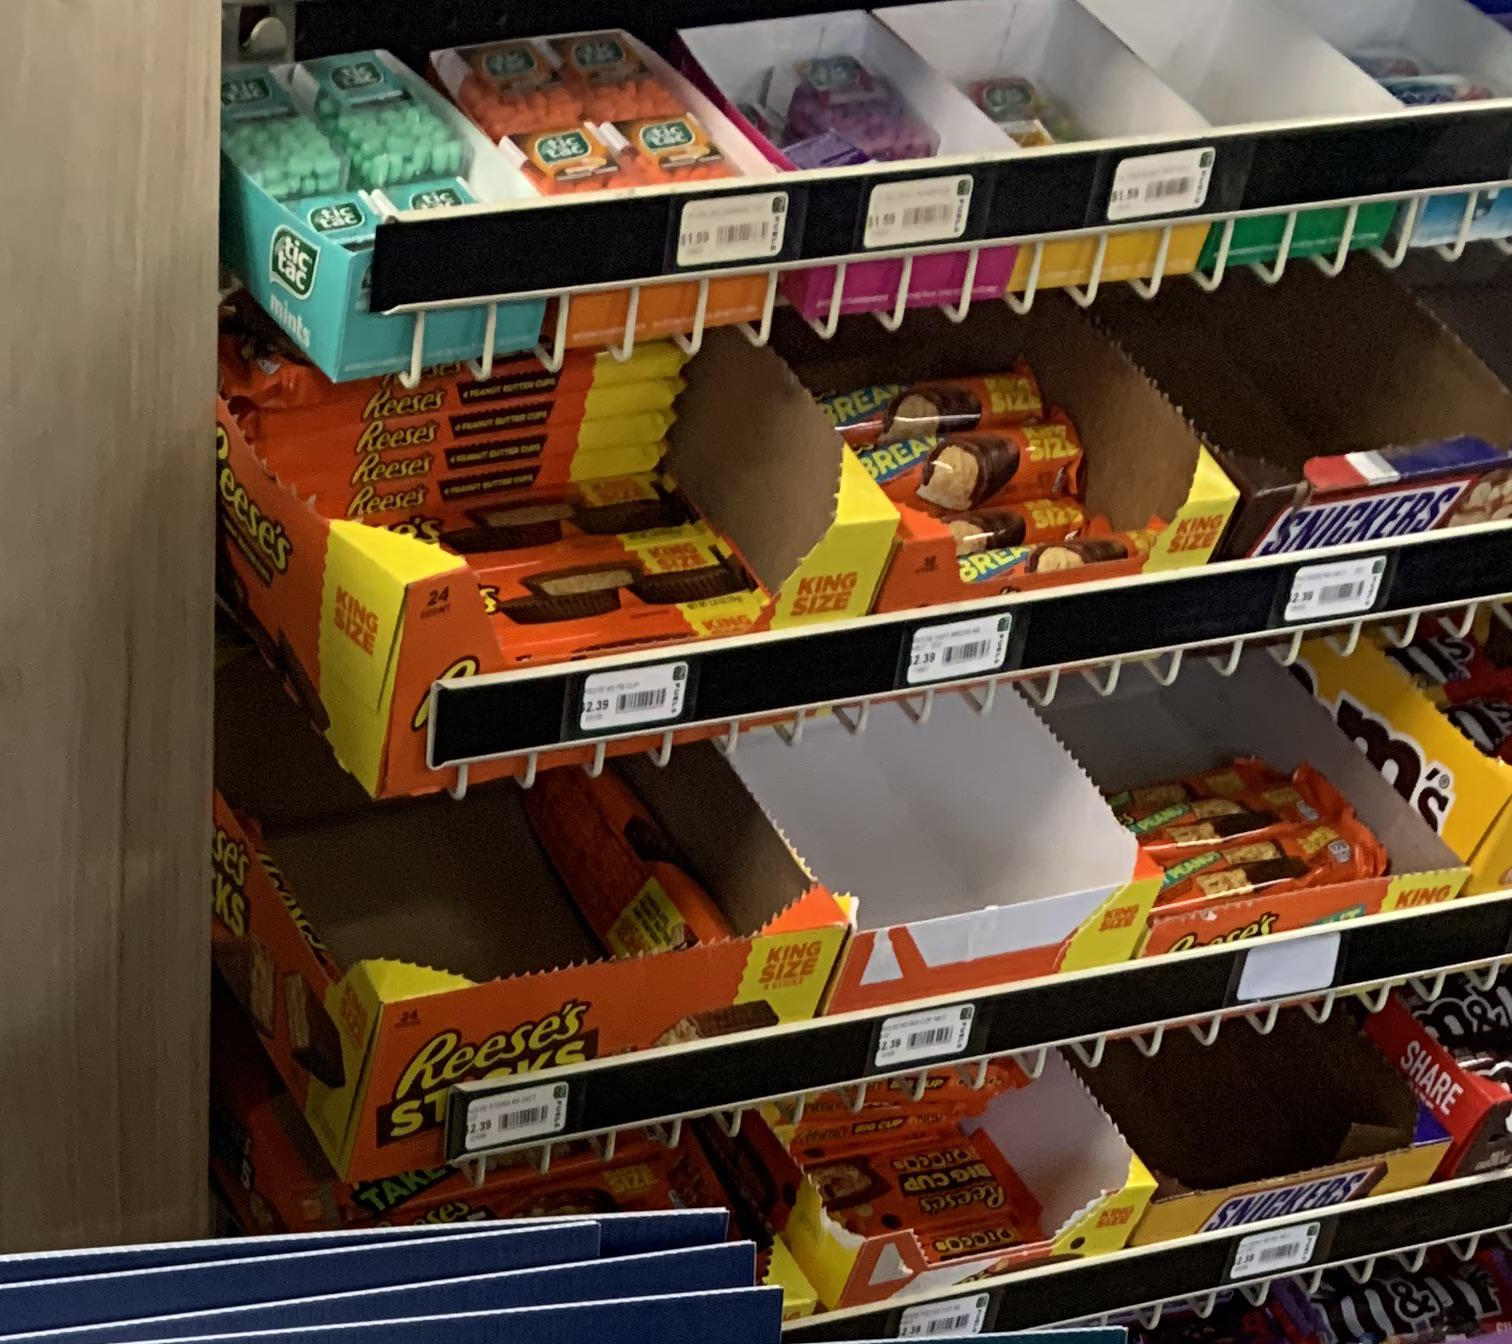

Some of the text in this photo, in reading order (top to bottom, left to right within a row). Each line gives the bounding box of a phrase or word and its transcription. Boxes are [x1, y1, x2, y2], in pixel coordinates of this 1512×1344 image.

[283, 235, 312, 272] tic
[277, 252, 308, 291] tac
[822, 383, 900, 424] BREA
[1178, 514, 1224, 531] KING
[1253, 486, 1461, 558] SNICKERS
[1168, 531, 1218, 553] SIZE
[959, 545, 1036, 583] BREA
[429, 586, 450, 607] 24
[797, 571, 859, 597] KING
[336, 586, 379, 630] KING
[790, 589, 853, 617] SIZE
[334, 606, 377, 656] SIZE
[1394, 884, 1453, 909] KING
[766, 941, 822, 963] KING
[758, 957, 816, 984] SIZE
[396, 1002, 587, 1100] Reese's
[1400, 1040, 1464, 1116] SHARE
[903, 1173, 946, 1192] CUP
